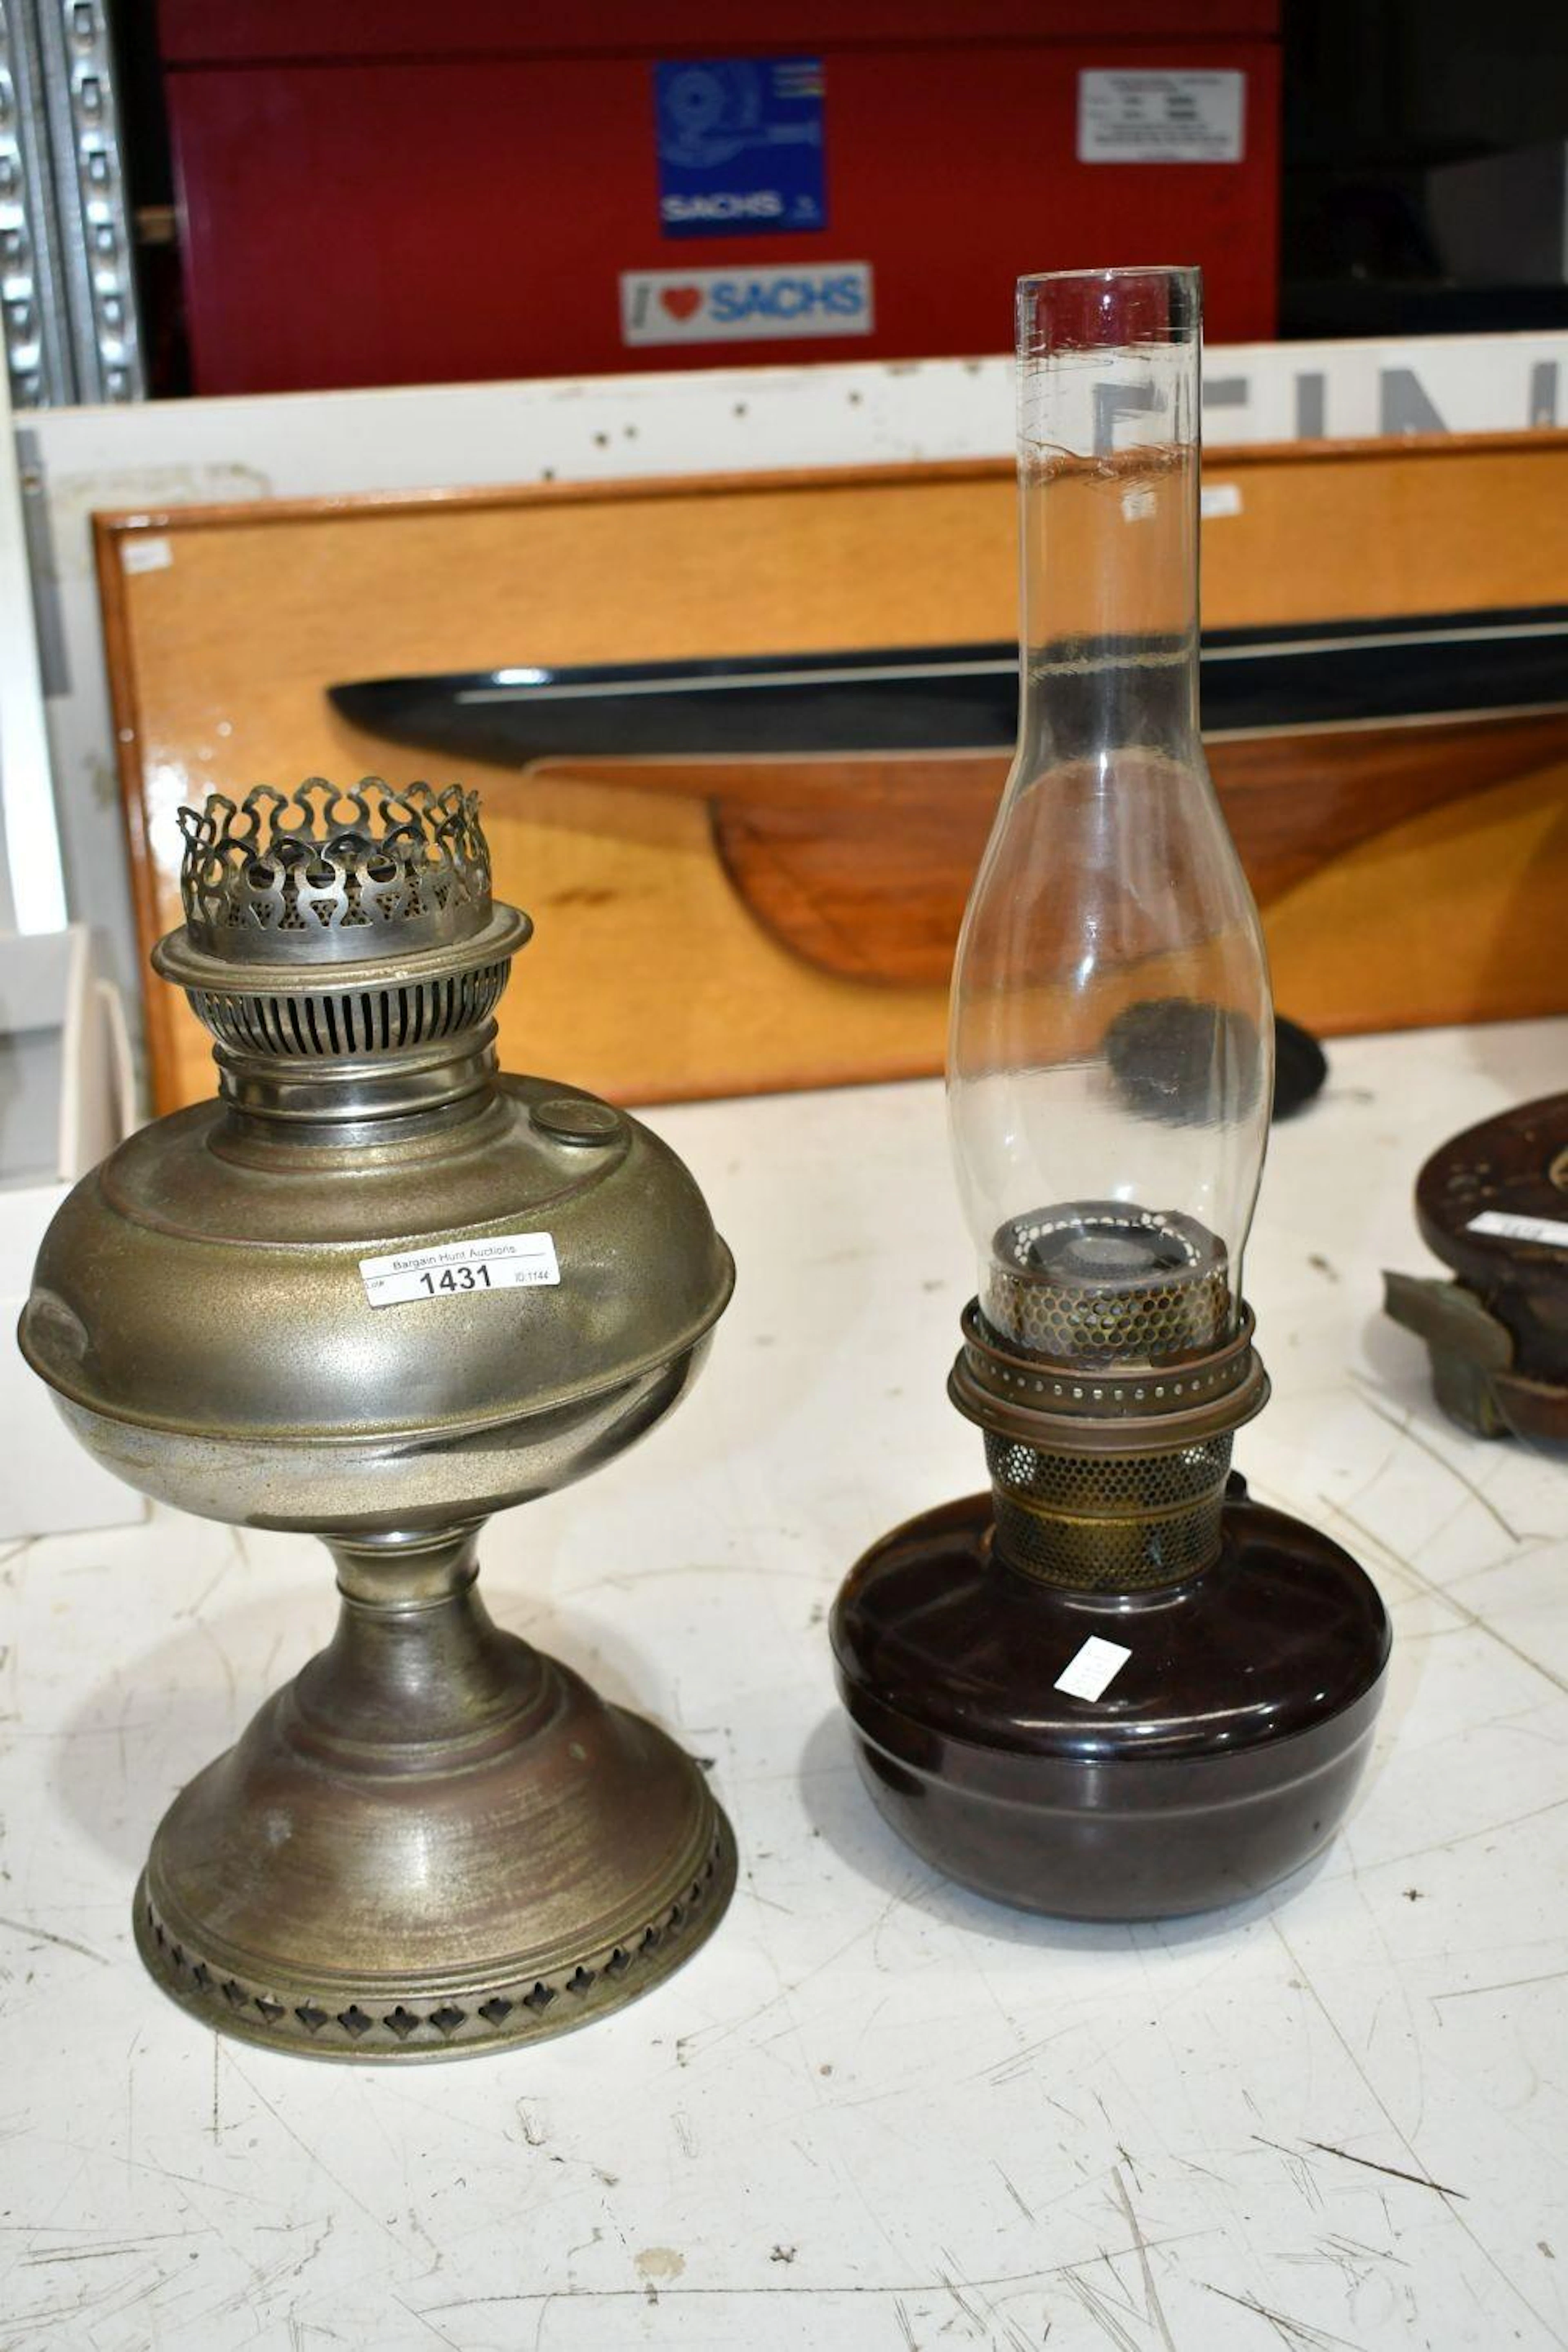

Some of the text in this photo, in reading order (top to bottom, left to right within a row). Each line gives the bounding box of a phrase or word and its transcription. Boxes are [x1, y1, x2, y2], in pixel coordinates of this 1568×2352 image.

[662, 190, 782, 220] SACHS
[632, 275, 863, 328] I SACHS
[393, 1245, 517, 1270] Bargain Hunt Auctions
[420, 1265, 491, 1294] 1431
